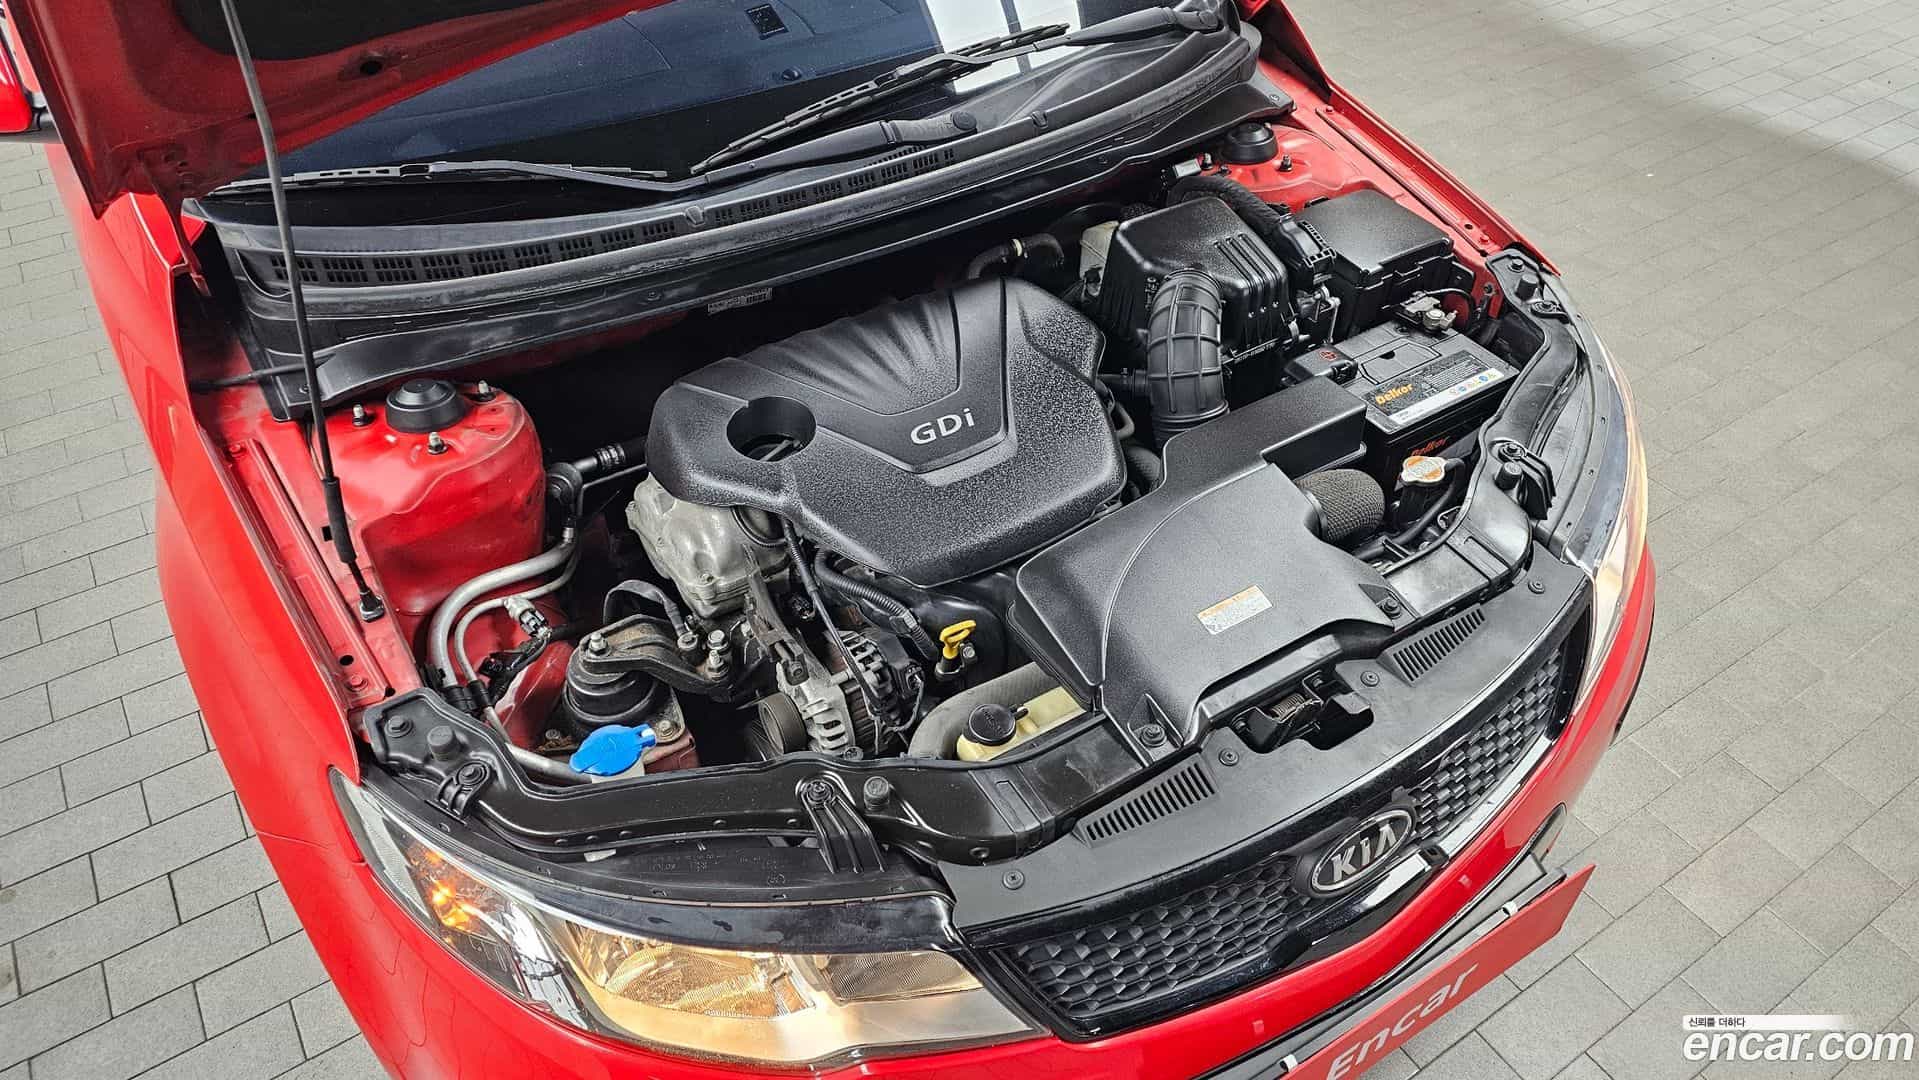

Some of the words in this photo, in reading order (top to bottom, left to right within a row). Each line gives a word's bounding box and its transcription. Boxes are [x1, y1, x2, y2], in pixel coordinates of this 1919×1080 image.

[1375, 383, 1414, 405] Delkor
[910, 407, 975, 445] GDi
[1331, 823, 1397, 883] KIA
[1326, 963, 1479, 1080] Encar
